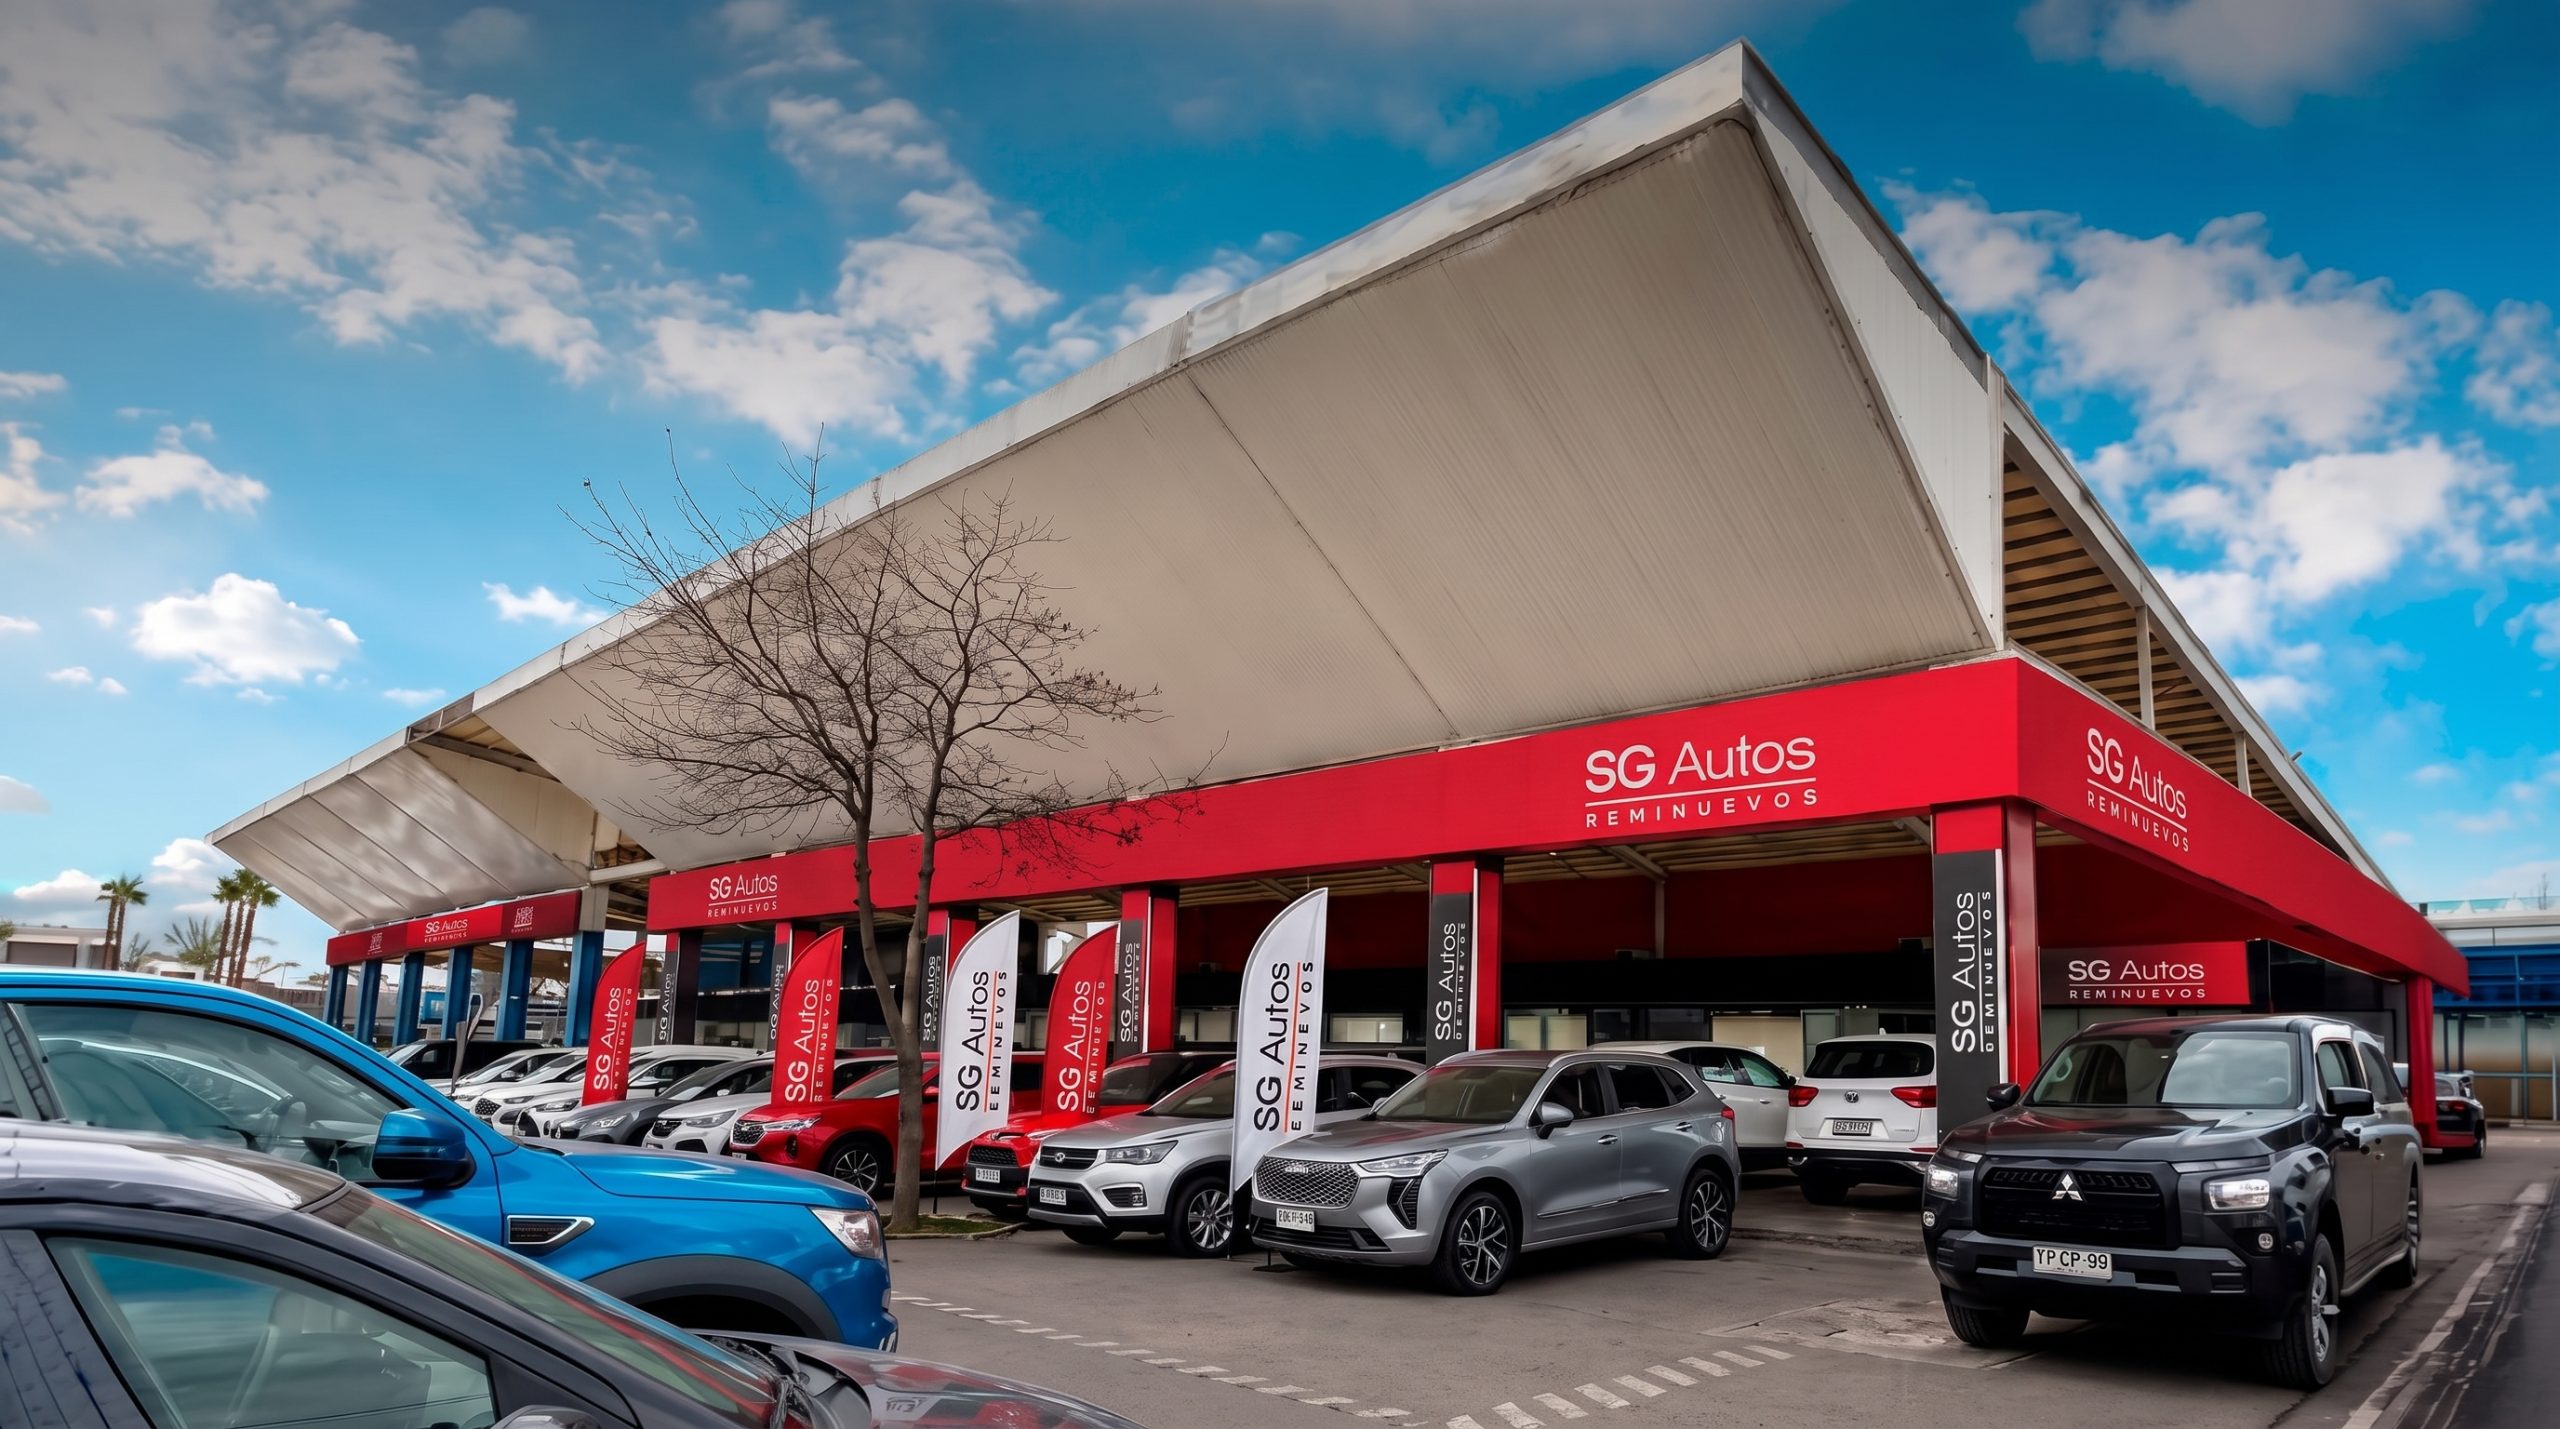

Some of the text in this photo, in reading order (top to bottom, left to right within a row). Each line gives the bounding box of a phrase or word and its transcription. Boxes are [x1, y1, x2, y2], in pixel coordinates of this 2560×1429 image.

[1585, 735, 1816, 793] SG Autos
[1585, 789, 1817, 828] REMINUEVOS
[2087, 728, 2187, 820] SG Autos
[2088, 790, 2189, 852] REMINUEVOS
[708, 901, 778, 918] REMINUEVOS
[709, 873, 778, 900] SG Autos
[1121, 943, 1133, 1042] SG Autos
[1435, 923, 1456, 1041] SG Autos
[1951, 891, 1976, 1053] SG Autos
[2068, 960, 2205, 981] SG Autos
[2069, 988, 2206, 999] REMINUEVOS
[593, 987, 622, 1090] SG Autos
[785, 979, 819, 1102] SG Autos
[956, 971, 989, 1112] SG Autos
[1057, 980, 1090, 1111] SG Autos
[1254, 962, 1290, 1132] SG Autos
